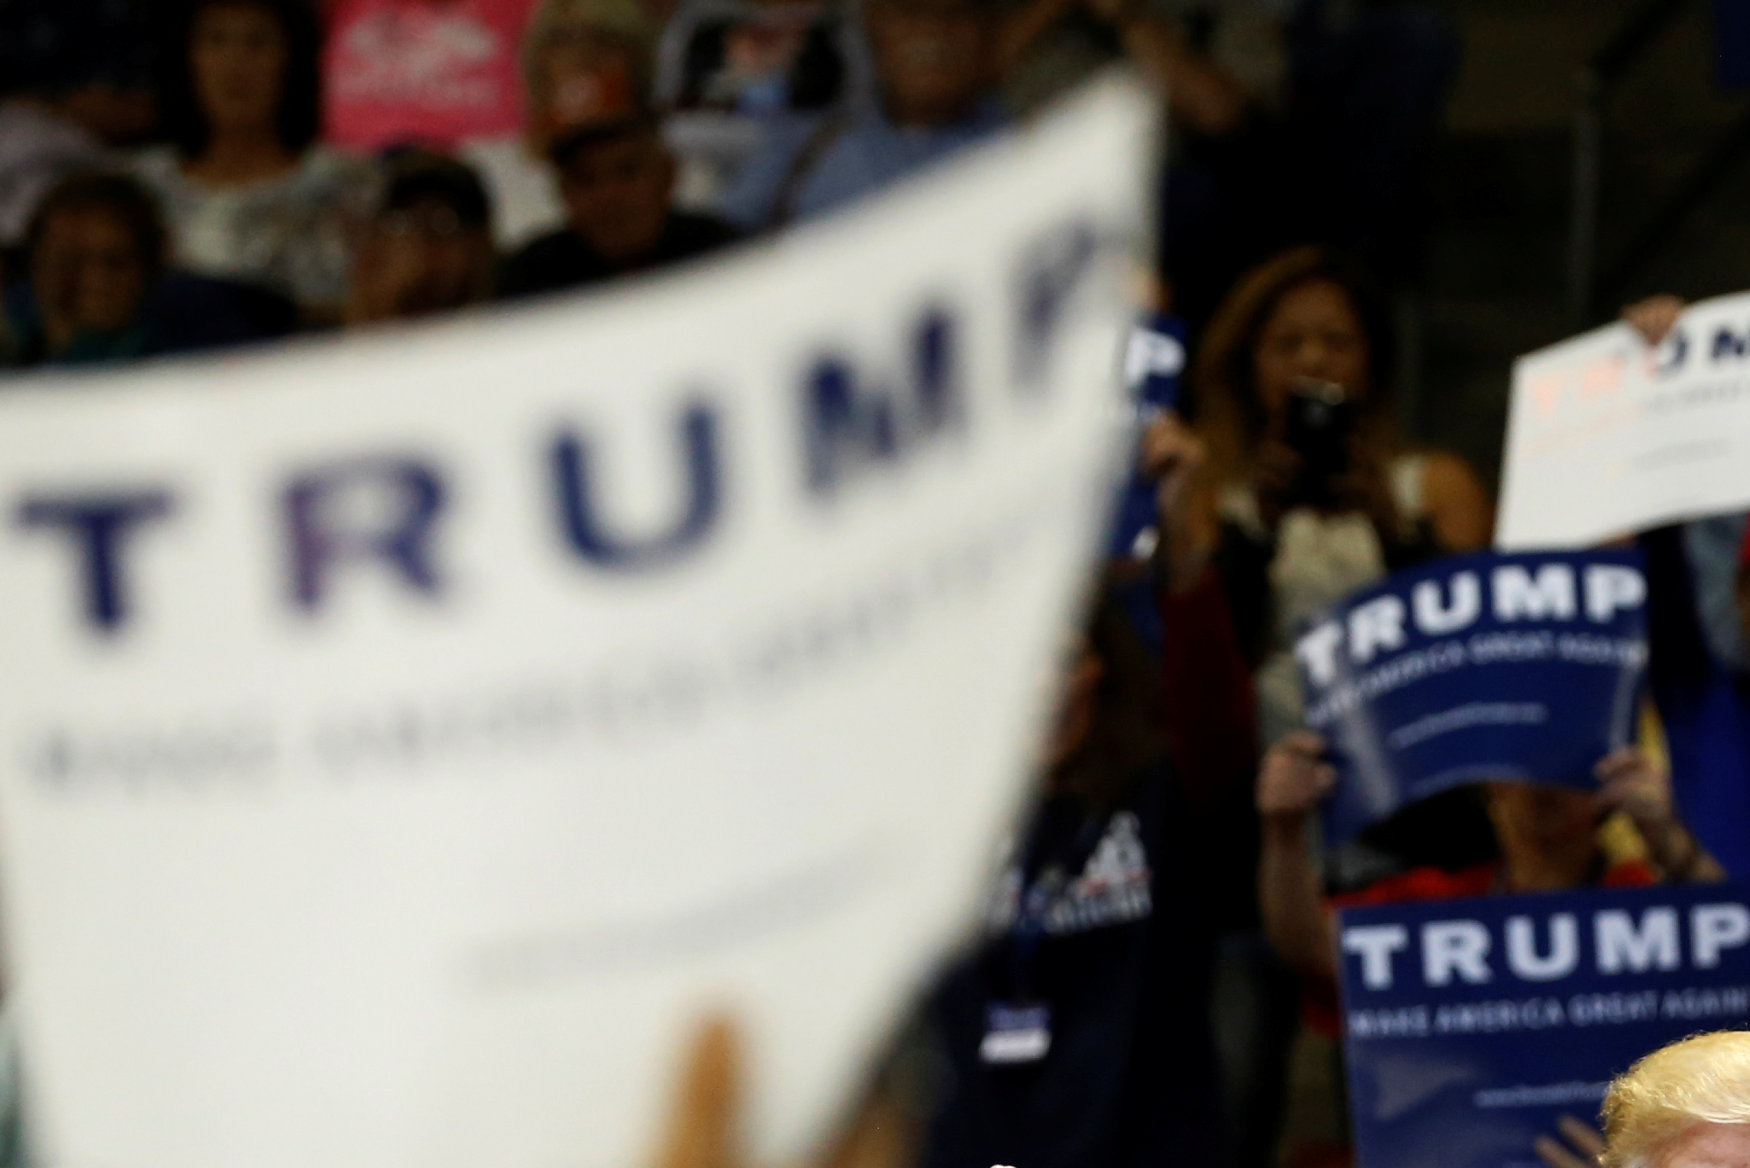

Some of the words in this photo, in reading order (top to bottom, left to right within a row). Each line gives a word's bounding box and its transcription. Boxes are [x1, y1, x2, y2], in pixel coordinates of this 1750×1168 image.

[1298, 562, 1647, 688] TRUMP
[1434, 999, 1567, 1033] AMERICA
[1567, 991, 1658, 1026] GREAT
